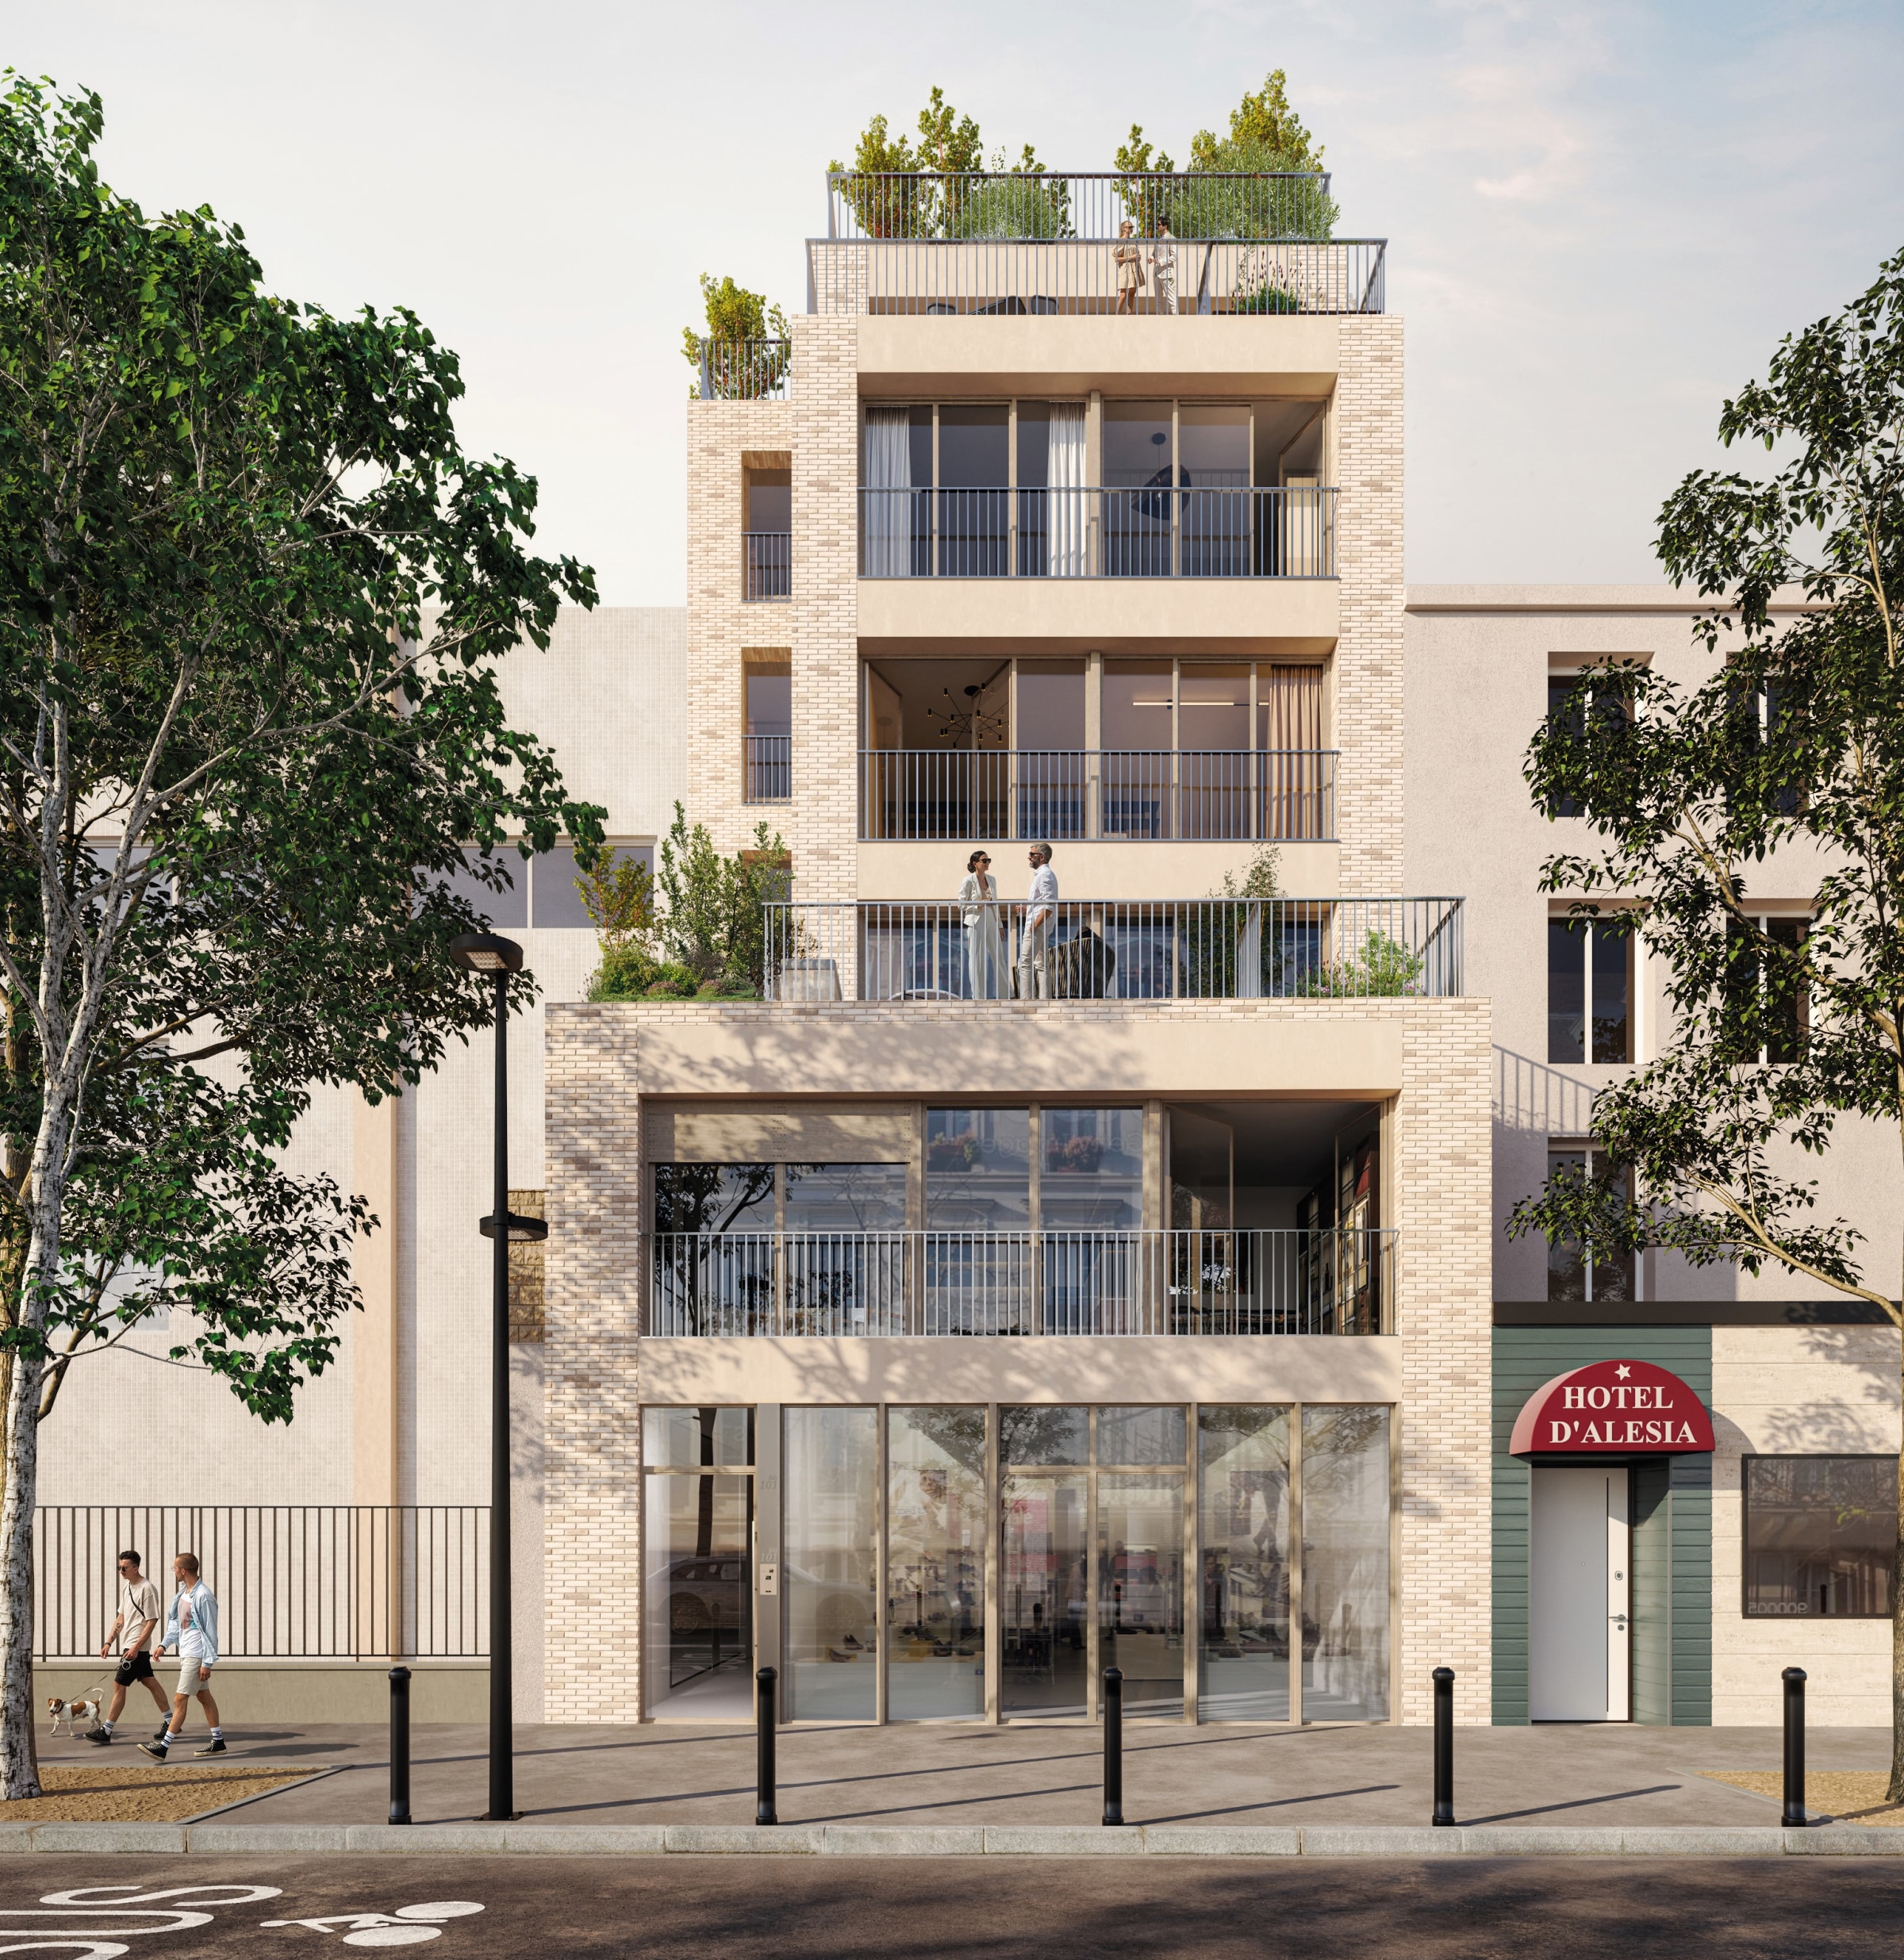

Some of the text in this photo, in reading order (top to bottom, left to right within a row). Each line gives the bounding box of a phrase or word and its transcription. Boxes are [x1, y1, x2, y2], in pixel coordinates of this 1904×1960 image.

[1562, 1386, 1674, 1410] HOTEL
[1549, 1421, 1698, 1444] D'ALESIA
[760, 1480, 777, 1490] 101
[760, 1553, 777, 1562] 101
[0, 1885, 283, 1960] US
